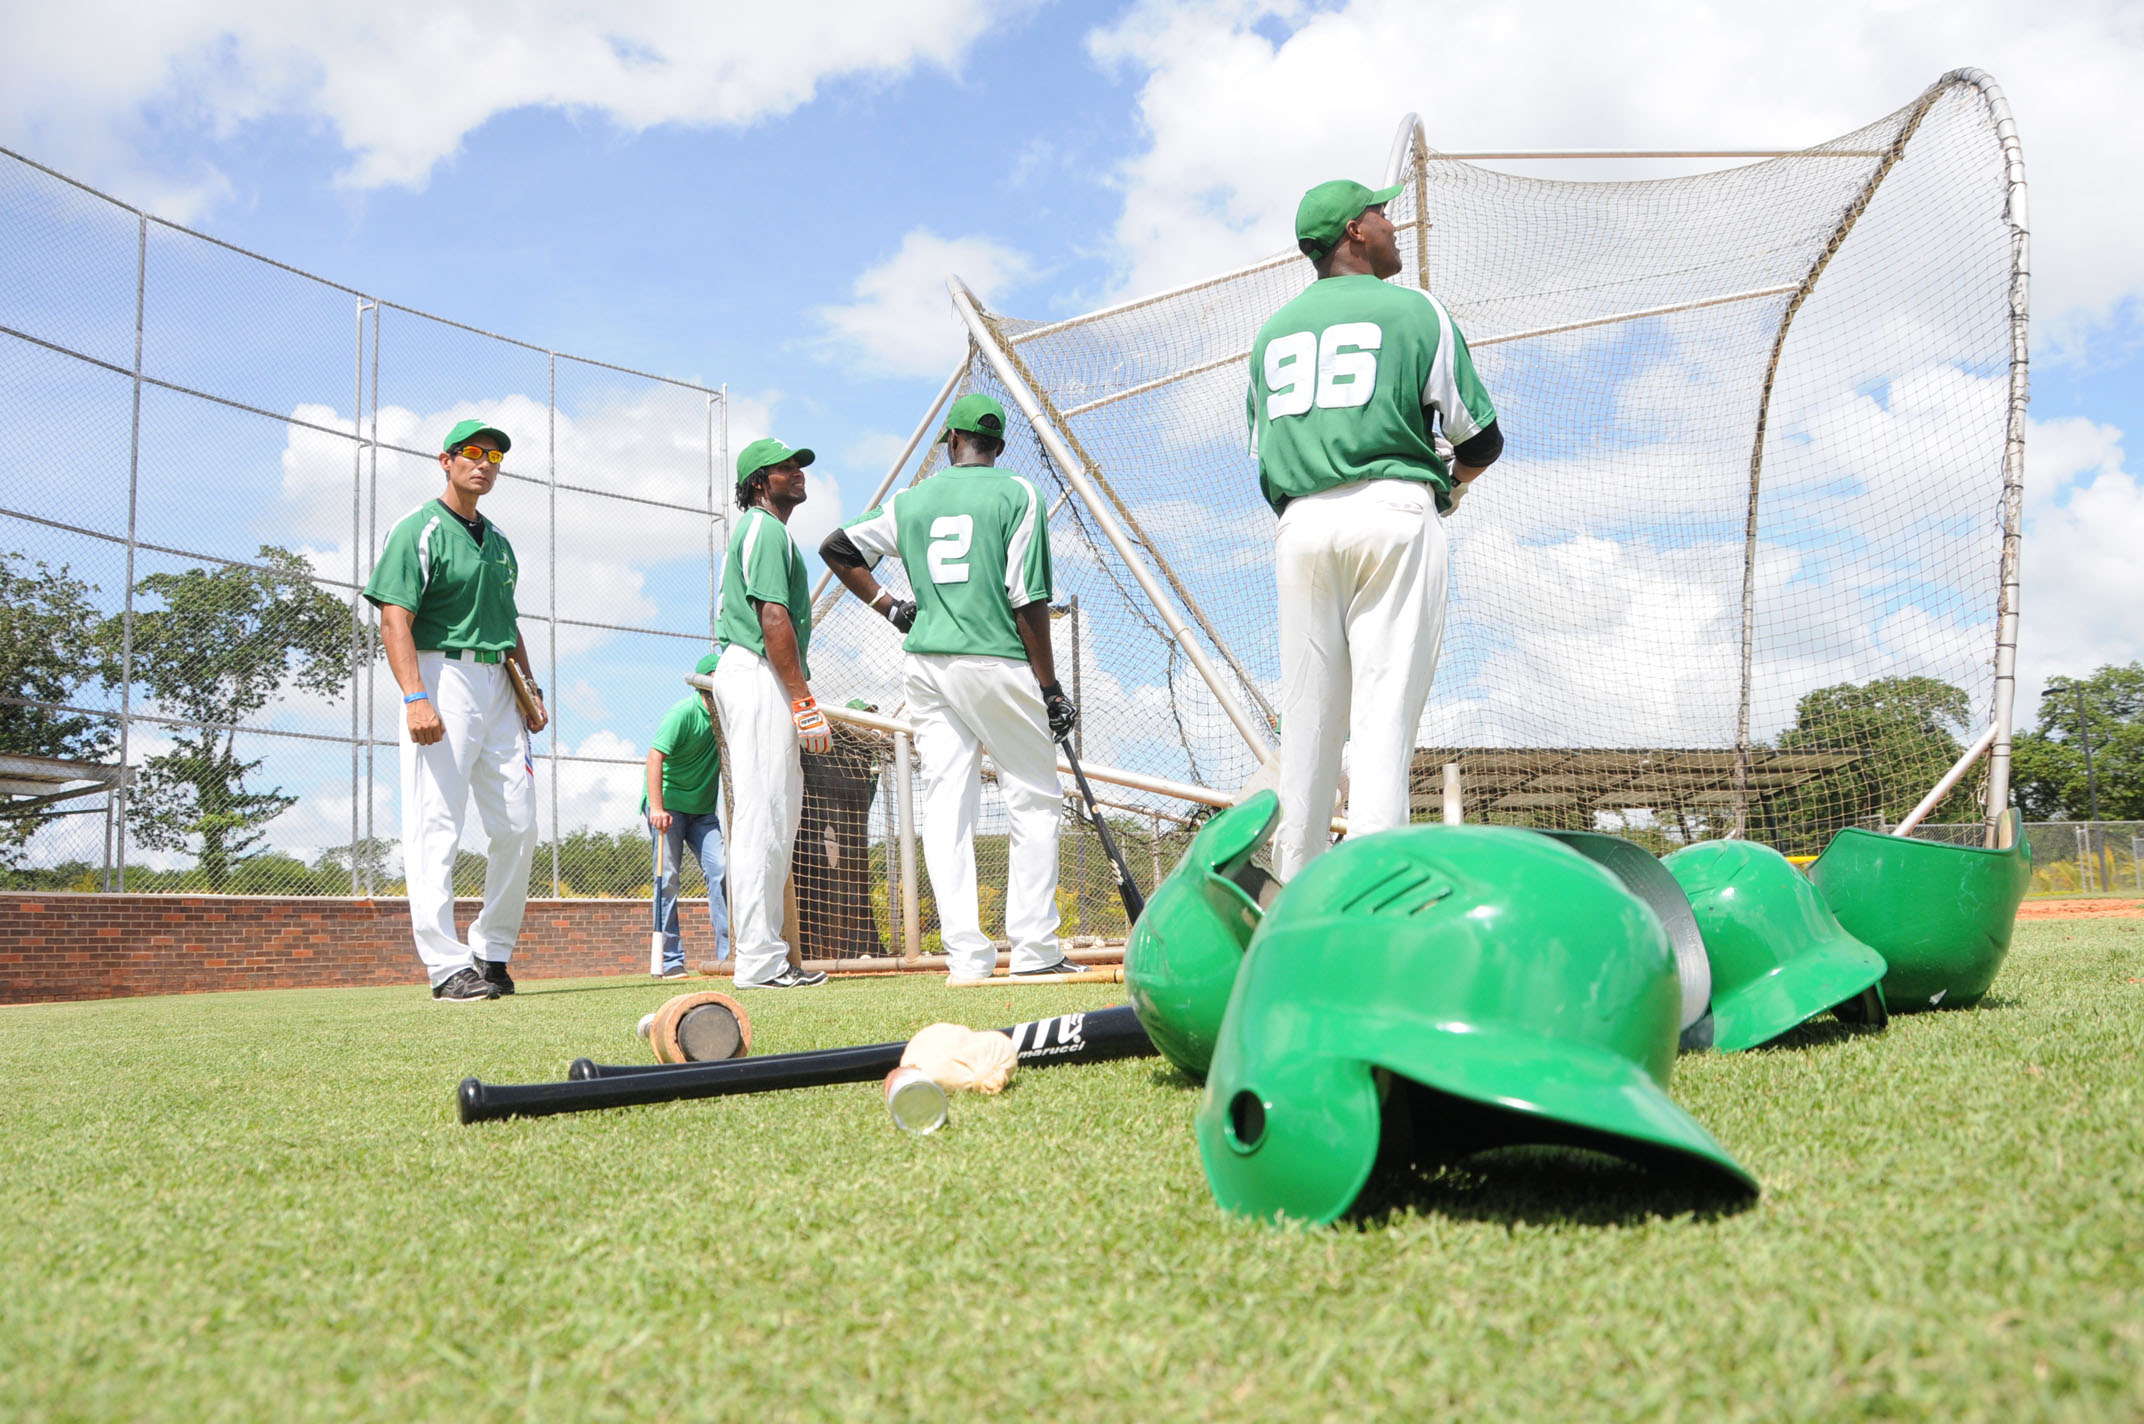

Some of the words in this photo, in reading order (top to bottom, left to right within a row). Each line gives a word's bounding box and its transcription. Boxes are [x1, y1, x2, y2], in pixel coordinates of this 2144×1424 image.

[1264, 322, 1382, 421] 96
[927, 514, 973, 585] 2
[1018, 1041, 1086, 1059] marucci
